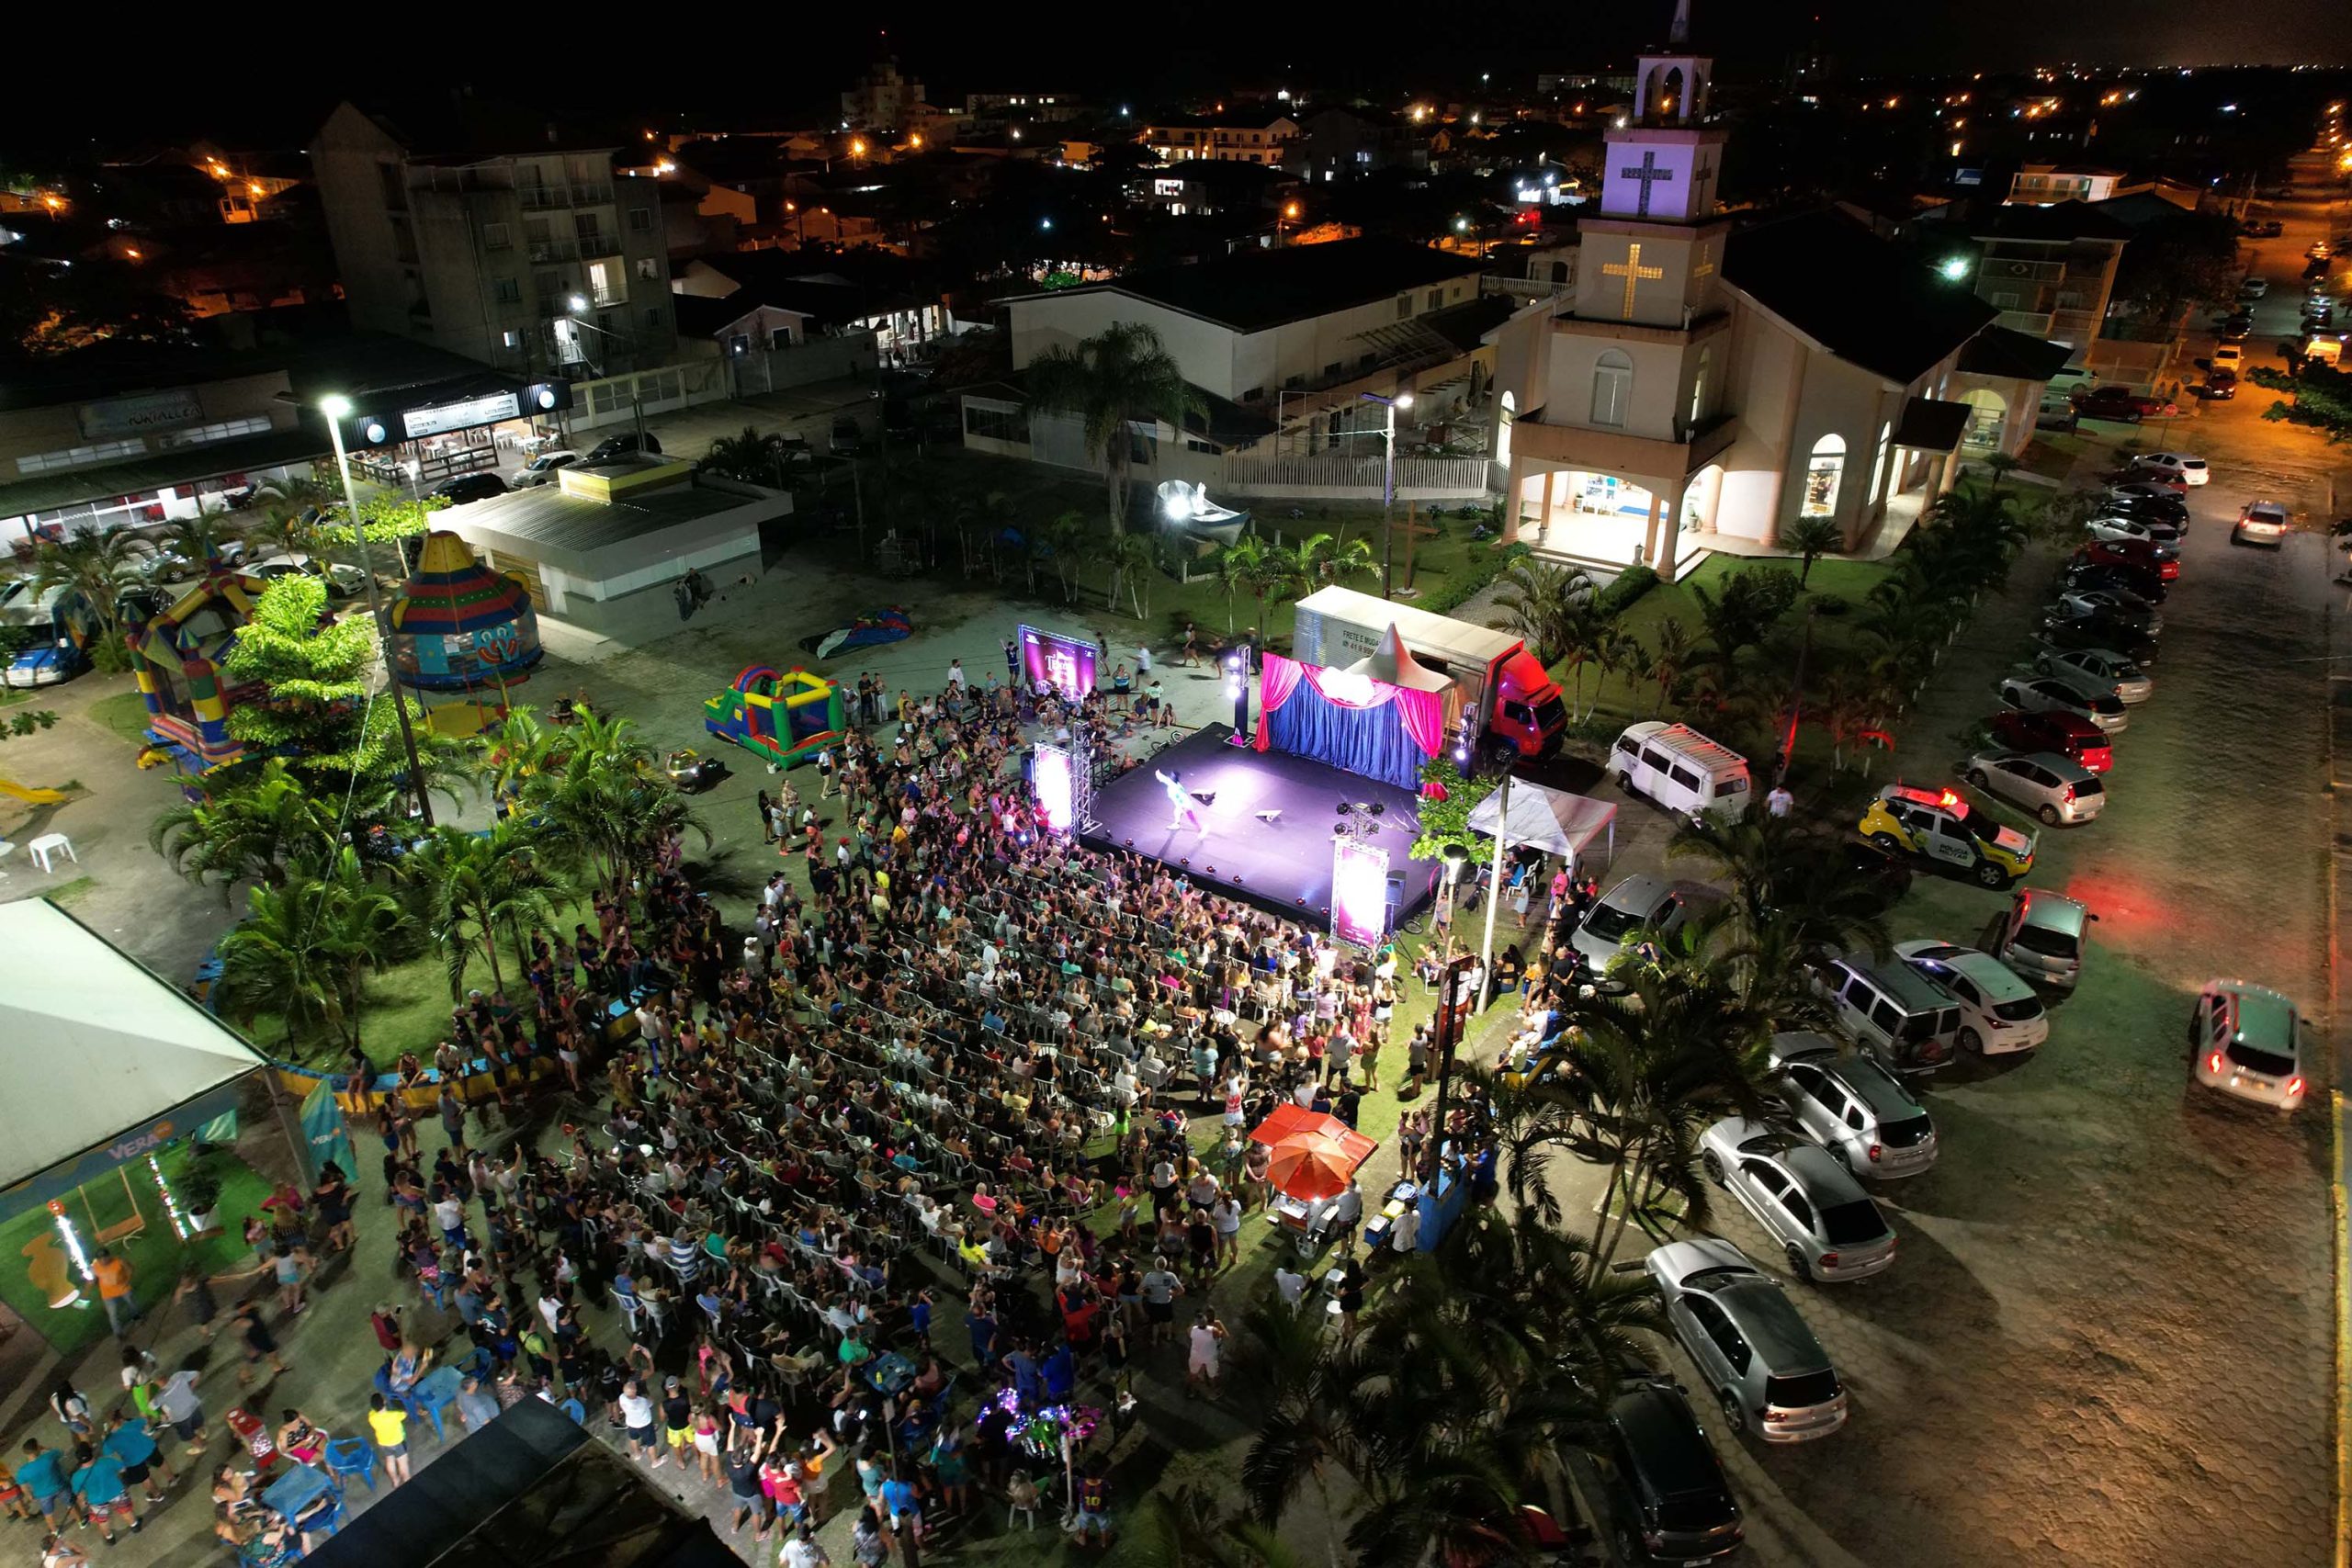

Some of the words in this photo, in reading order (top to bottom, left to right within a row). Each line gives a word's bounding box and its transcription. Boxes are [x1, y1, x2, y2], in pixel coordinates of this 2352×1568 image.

[1342, 630, 1359, 641] FRETE
[1364, 637, 1381, 647] MUDA
[1939, 849, 1968, 861] MILITAR
[1084, 1495, 1102, 1506] 10
